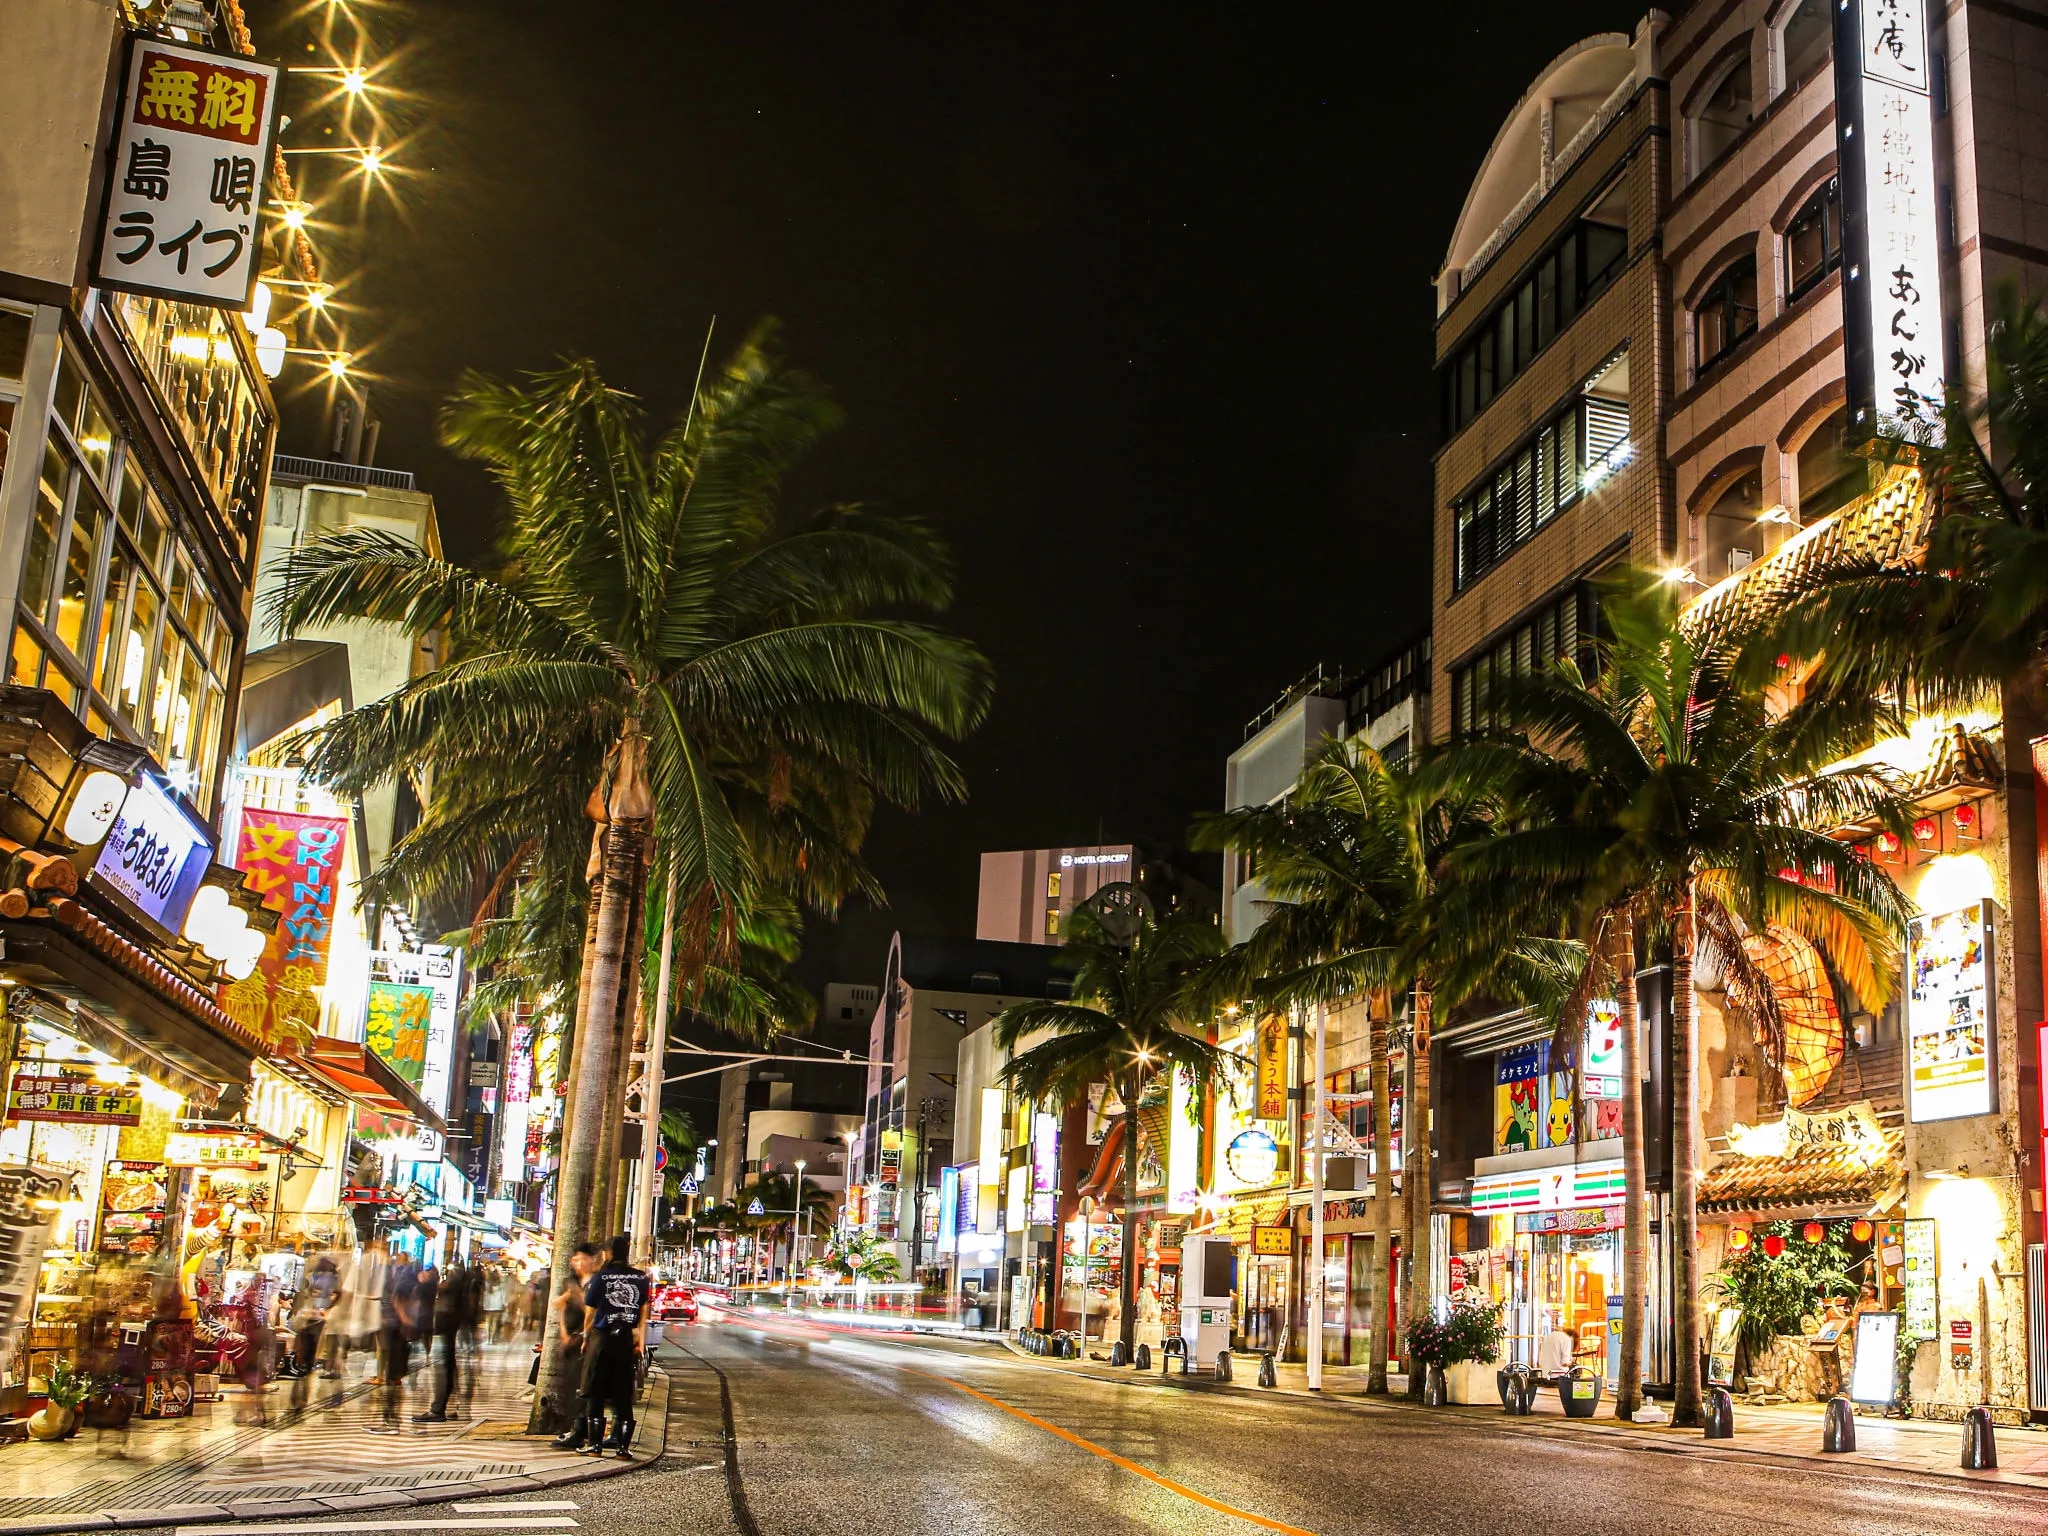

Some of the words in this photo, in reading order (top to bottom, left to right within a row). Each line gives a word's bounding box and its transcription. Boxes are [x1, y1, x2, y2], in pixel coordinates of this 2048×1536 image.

[139, 59, 257, 136] 無料
[112, 210, 250, 279] ライブ
[1889, 263, 1927, 423] あんがま
[122, 819, 178, 900] ちぬまん
[1074, 854, 1097, 865] HOTEL
[1097, 853, 1129, 864] GRACERY
[283, 826, 341, 963] OKINAWA
[393, 991, 430, 1062] 沖縄
[18, 1079, 139, 1097] 島唄三線ライブ
[20, 1093, 49, 1109] 無料
[56, 1094, 133, 1114] 開催中!
[1501, 1061, 1539, 1080] ポケモンと
[467, 1145, 483, 1183] イーオン
